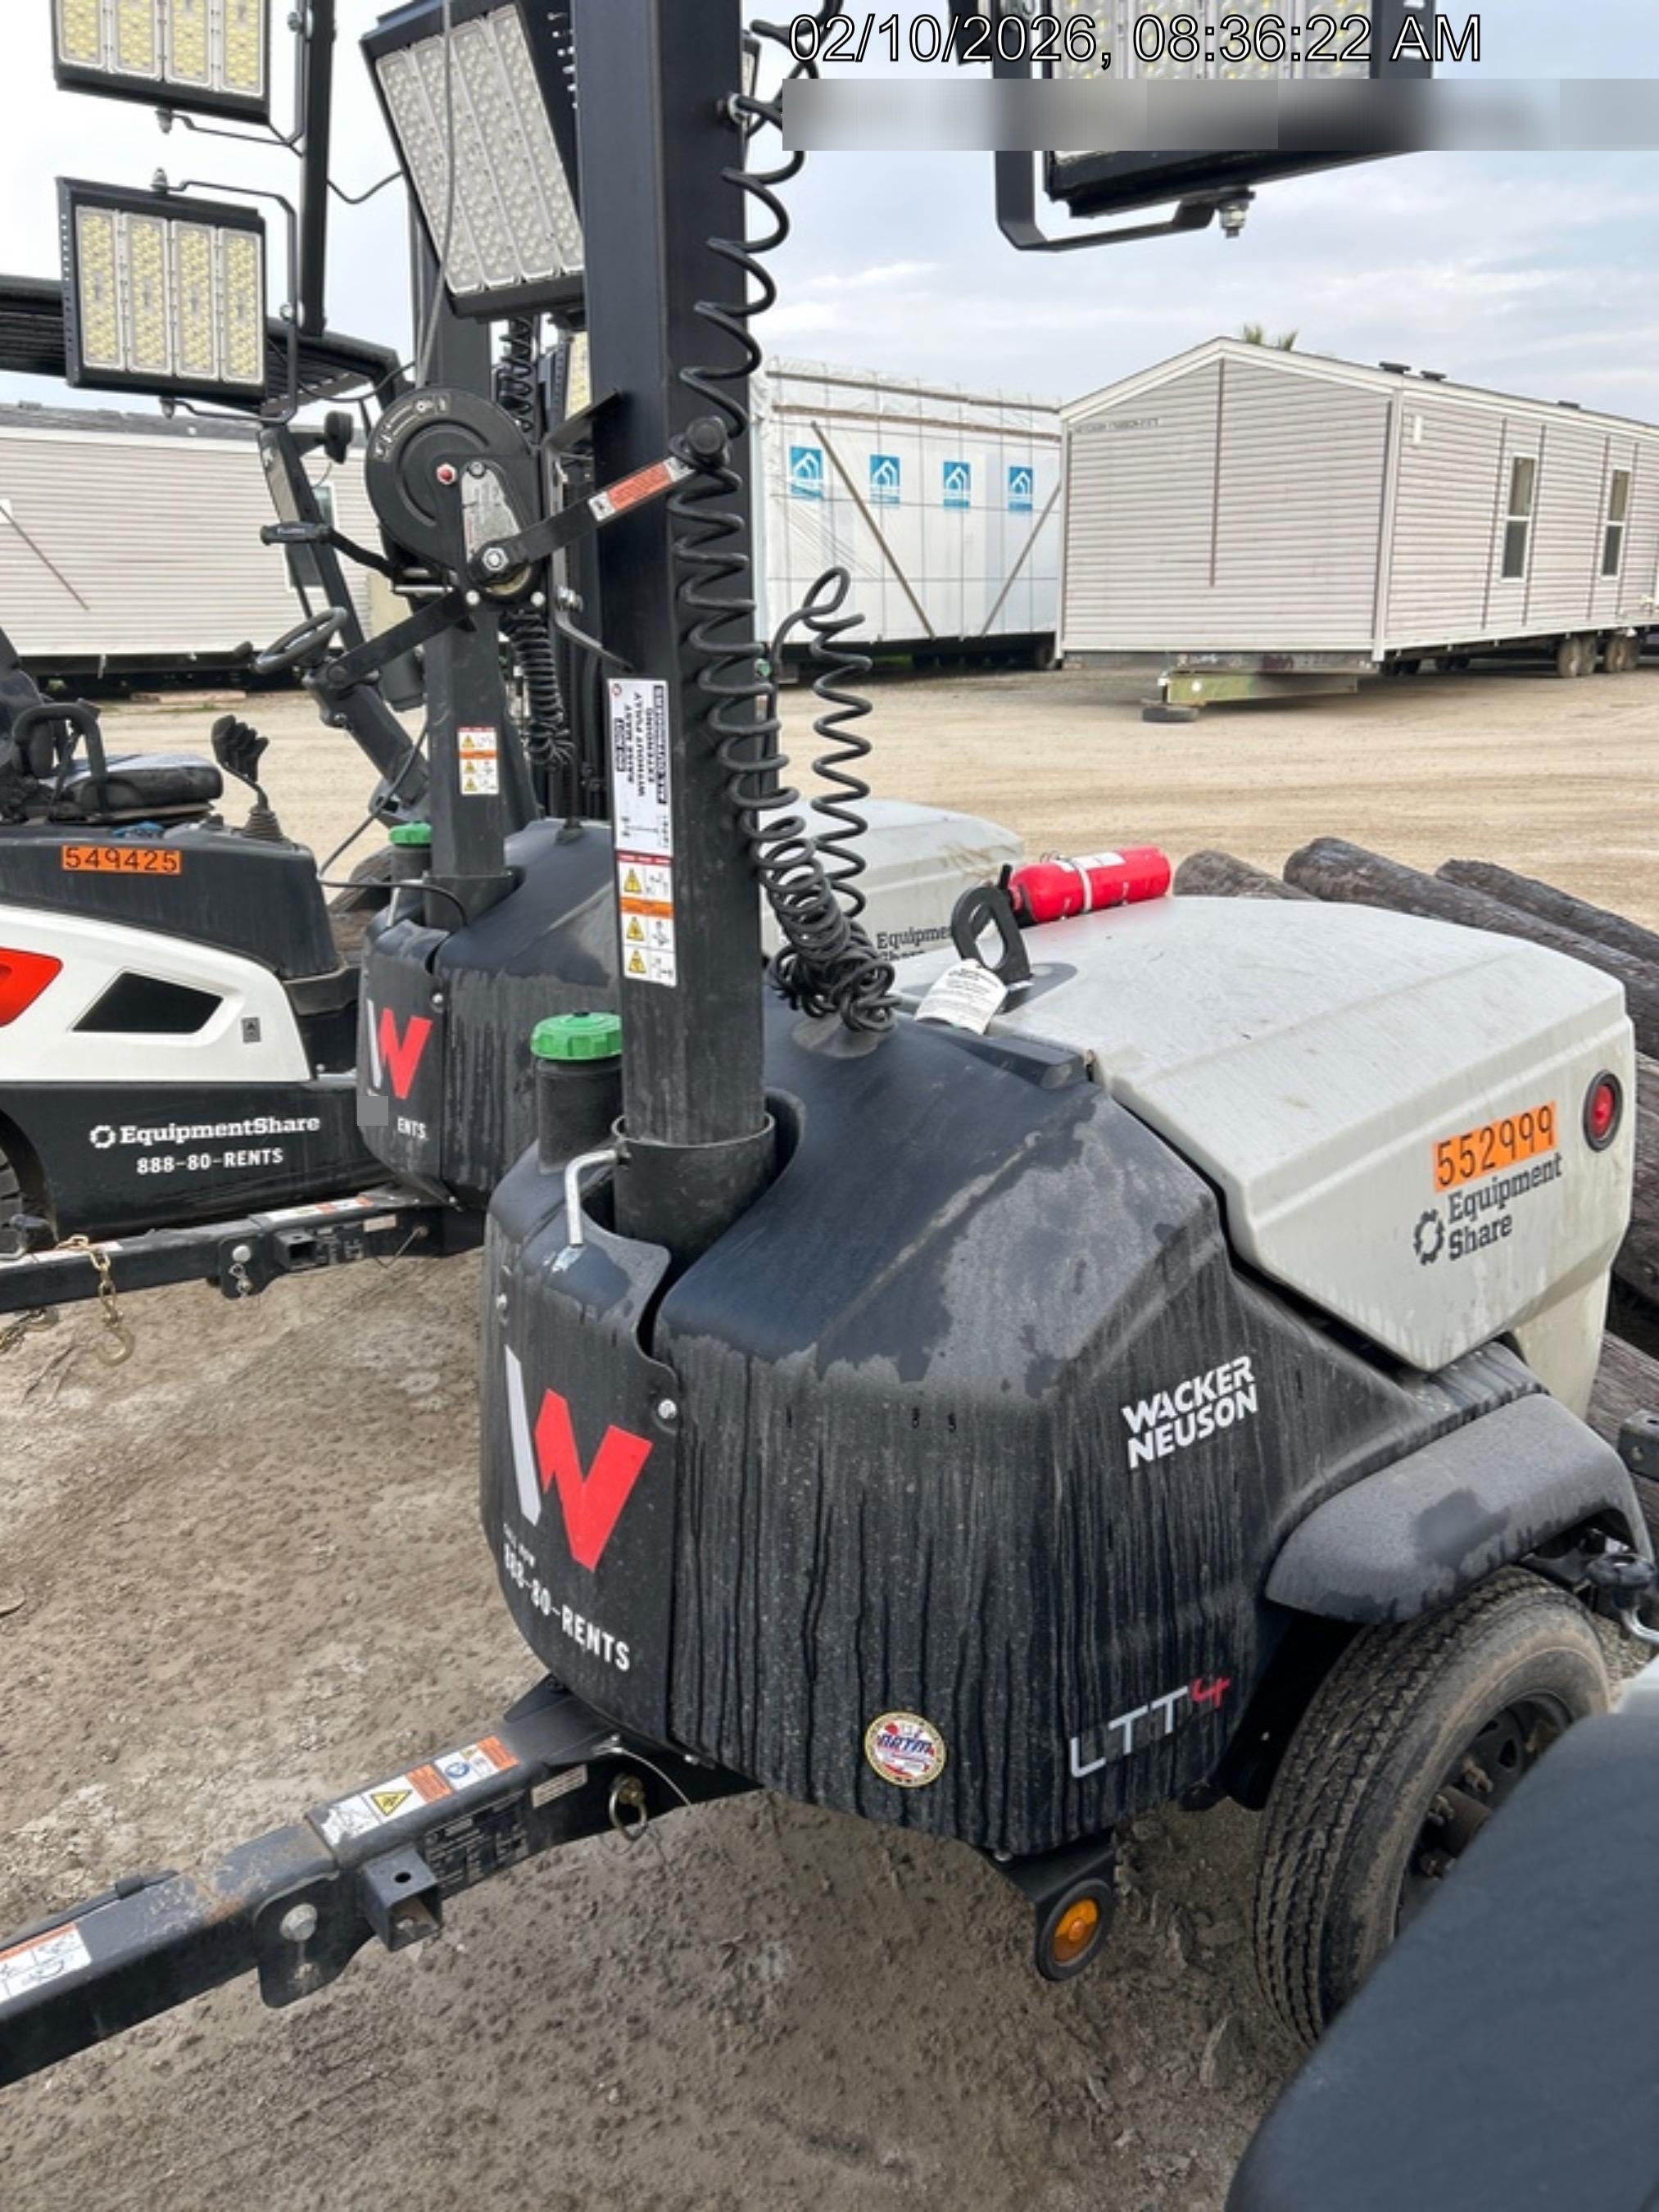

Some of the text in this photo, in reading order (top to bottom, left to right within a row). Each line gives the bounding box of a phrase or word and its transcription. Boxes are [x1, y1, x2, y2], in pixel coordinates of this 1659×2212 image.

[66, 846, 177, 871] 549425
[877, 926, 951, 949] Equipme
[119, 1116, 320, 1146] EquipmentShare
[1437, 1104, 1554, 1186] 552999
[136, 1147, 283, 1175] 888-80-RENTS
[1448, 1152, 1562, 1224] Equipment
[1448, 1214, 1513, 1262] Share
[1121, 1355, 1255, 1434] WACKER
[1127, 1384, 1258, 1469] NEUSON
